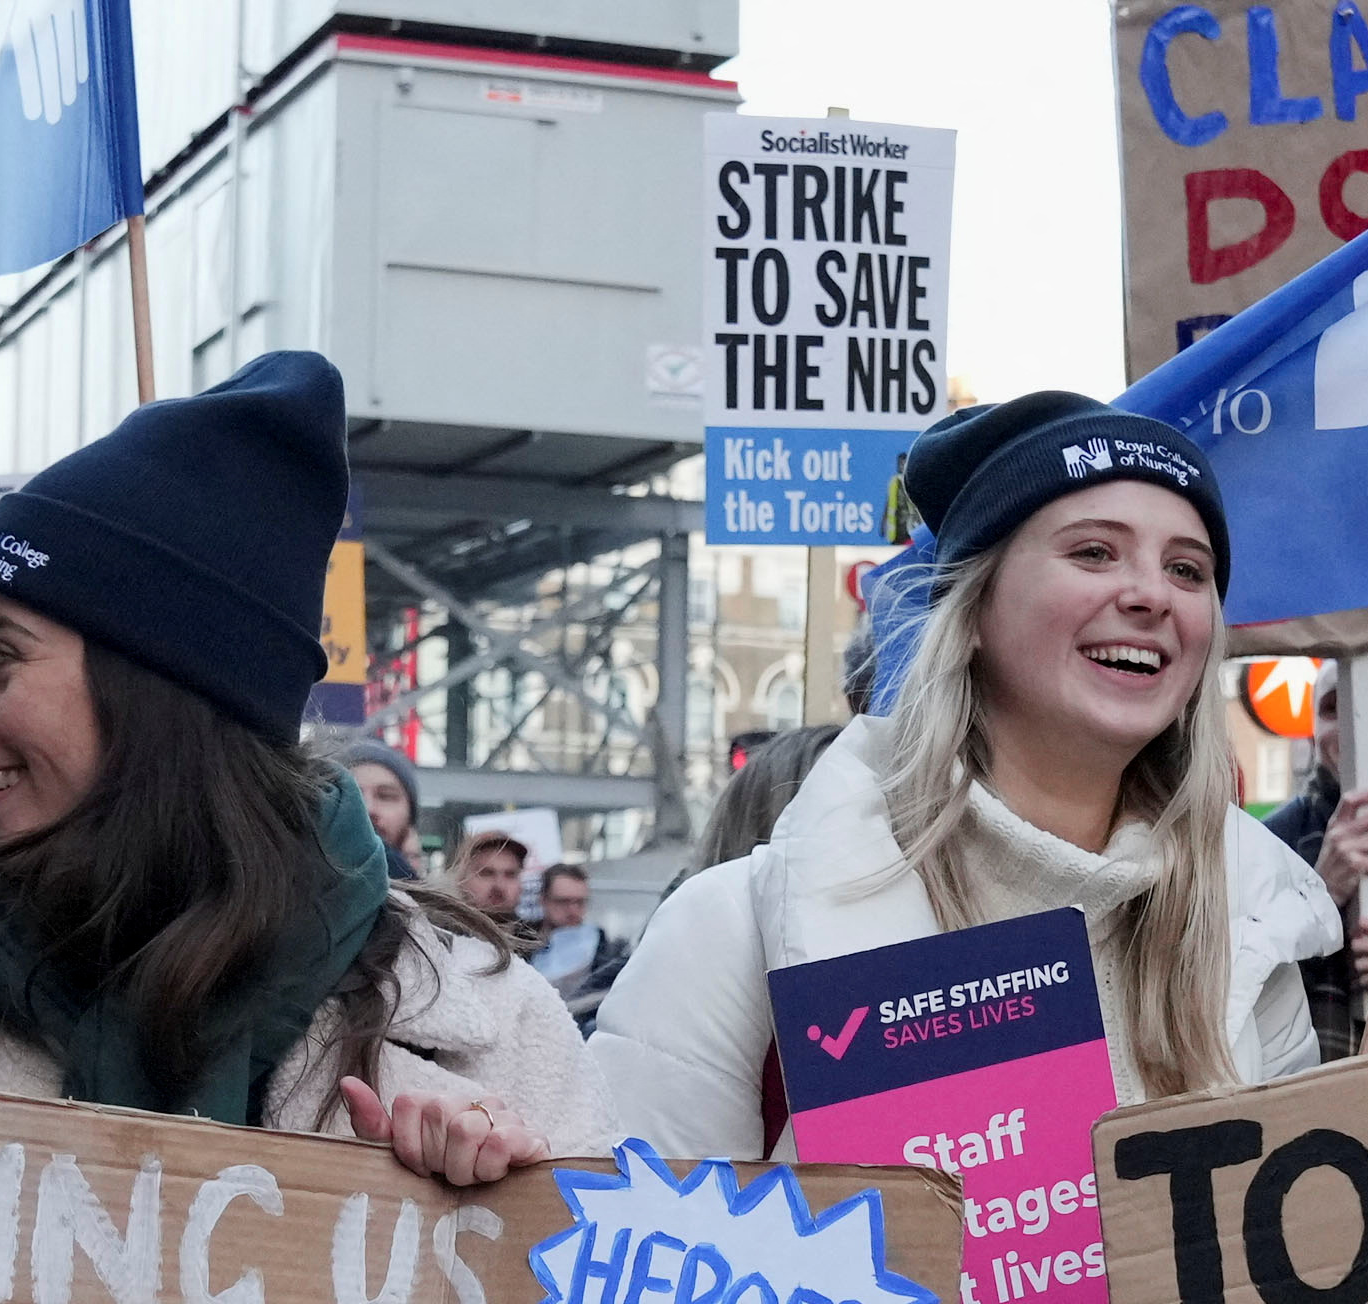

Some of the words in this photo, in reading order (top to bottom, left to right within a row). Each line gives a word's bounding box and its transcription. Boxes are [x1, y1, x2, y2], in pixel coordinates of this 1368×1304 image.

[761, 130, 847, 156] Socialist
[850, 134, 909, 160] Worker
[718, 160, 908, 246] STRIKE
[715, 248, 790, 326] TO
[815, 250, 930, 331] SAVE
[715, 333, 824, 411] THE
[846, 337, 936, 415] NHS
[724, 438, 792, 482] Kick
[802, 442, 852, 482] out
[1114, 439, 1155, 454] Royal
[1120, 453, 1135, 466] of
[1136, 453, 1189, 487] Nursing
[724, 490, 774, 533] the
[785, 490, 874, 534] Tories
[1, 535, 50, 568] College
[879, 988, 946, 1024] SAFE
[949, 960, 1070, 1008] STAFFING
[883, 1013, 963, 1049] SAVES
[968, 995, 1036, 1030] LIVES
[902, 1107, 1027, 1174] Staff
[963, 1172, 1099, 1238] tages
[991, 1242, 1106, 1304] lives
